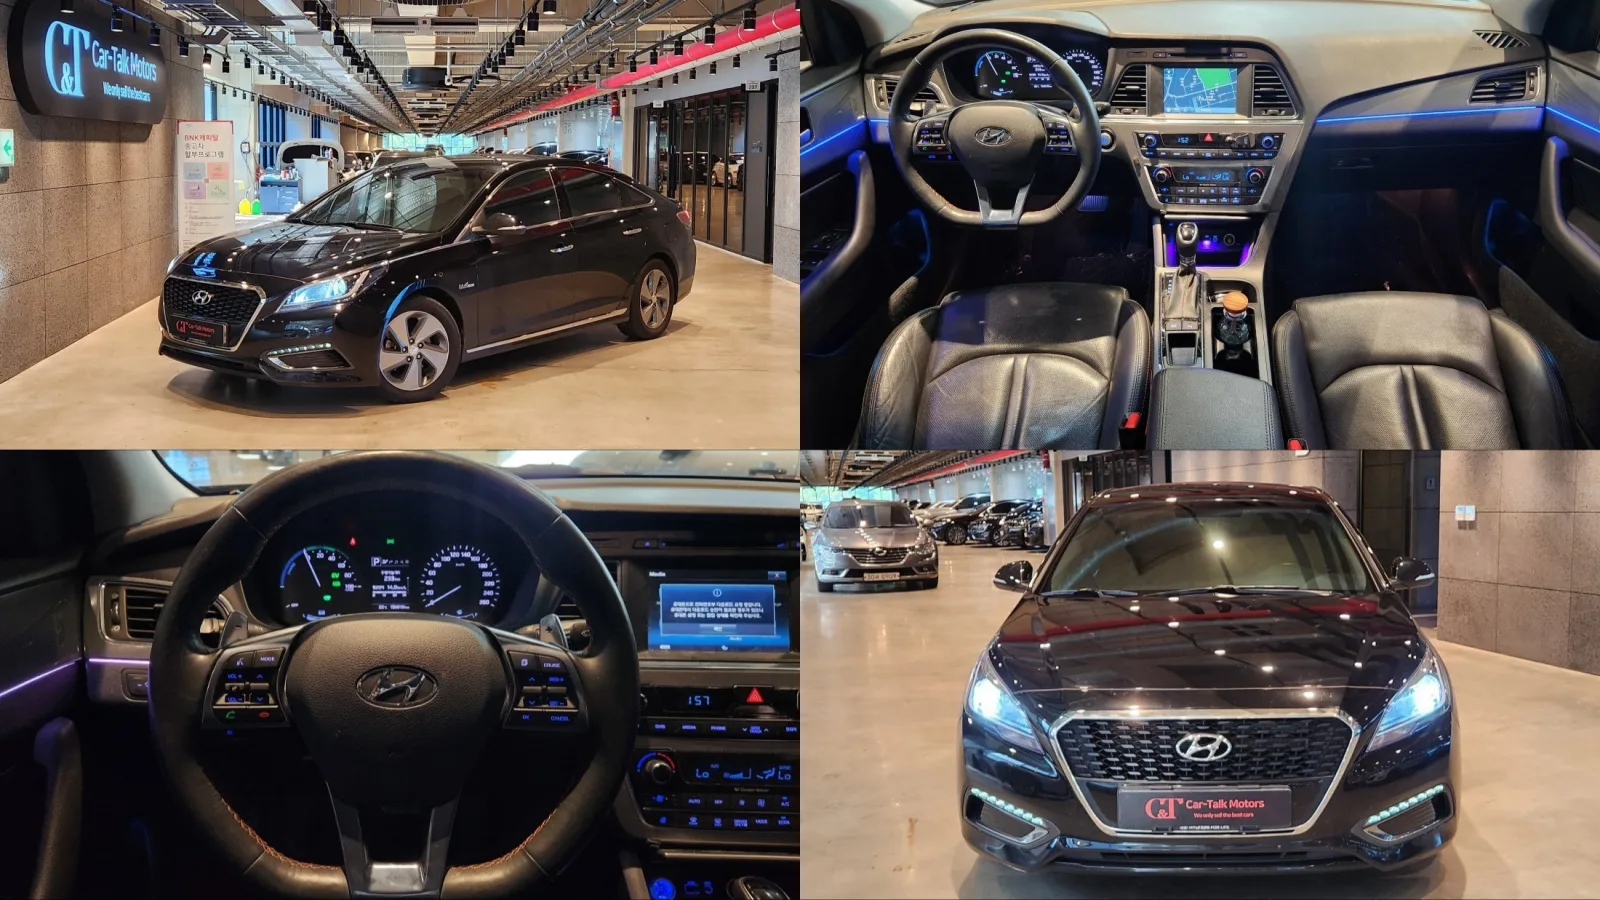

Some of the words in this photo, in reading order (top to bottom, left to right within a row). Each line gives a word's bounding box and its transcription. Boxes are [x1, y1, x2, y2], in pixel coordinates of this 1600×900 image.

[92, 40, 130, 76] Car-Talk
[130, 52, 157, 82] Motors
[103, 82, 111, 94] We
[112, 84, 121, 100] only
[134, 88, 143, 100] best
[688, 696, 710, 706] 157
[1186, 799, 1228, 809] Car-Talk
[1229, 799, 1265, 809] Motors
